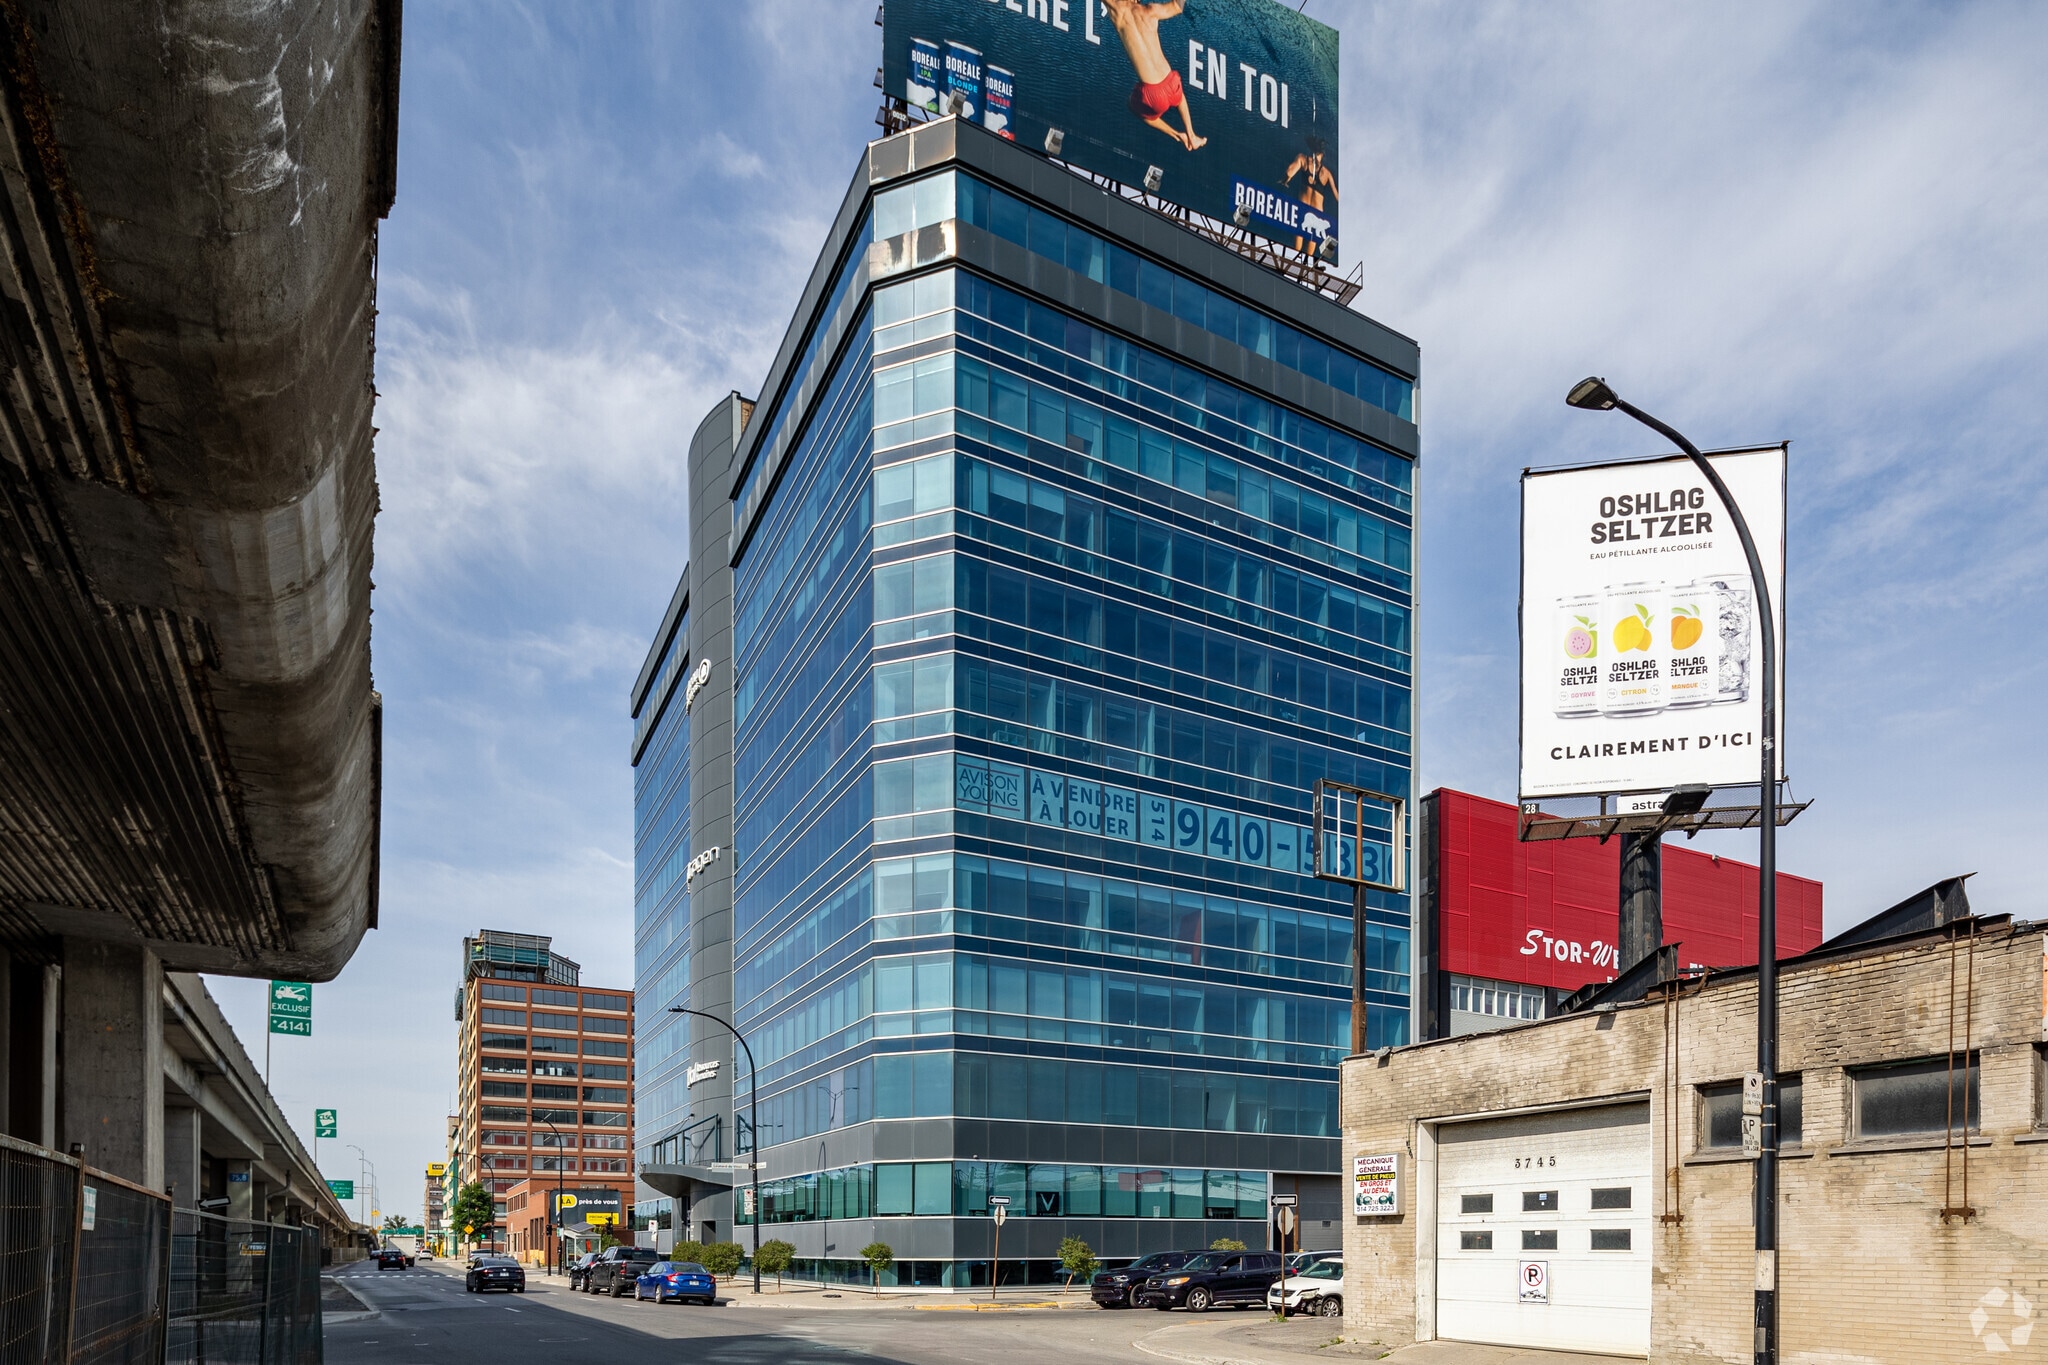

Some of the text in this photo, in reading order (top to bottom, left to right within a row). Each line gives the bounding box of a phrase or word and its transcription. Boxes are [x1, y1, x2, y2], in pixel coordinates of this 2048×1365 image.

[947, 76, 978, 94] BLONDE
[1189, 39, 1288, 129] EN TOI
[1600, 487, 1704, 518] OSHLAG
[1590, 512, 1713, 545] SELTZER
[1608, 547, 1658, 558] PÉTILLANTE
[1660, 541, 1713, 553] ALCOOLISÉE
[1612, 659, 1656, 672] OSHLAG
[1608, 669, 1659, 683] SELTZER
[1621, 687, 1647, 697] CITRON
[1551, 732, 1752, 760] CLAIREMENT D'ICI
[959, 768, 1018, 792] AVISON
[959, 782, 1018, 807] YOUNG
[1032, 774, 1135, 813] À VENDRE
[1525, 804, 1537, 814] 28
[1039, 800, 1129, 836] À LOUER
[1151, 800, 1165, 842] 514
[271, 1002, 311, 1013] EXCLUSIF
[1357, 1157, 1394, 1166] MÉCANIQUE
[1359, 1165, 1391, 1173] GÉNÉRALE
[1515, 1156, 1555, 1169] 3745
[578, 1198, 593, 1206] près
